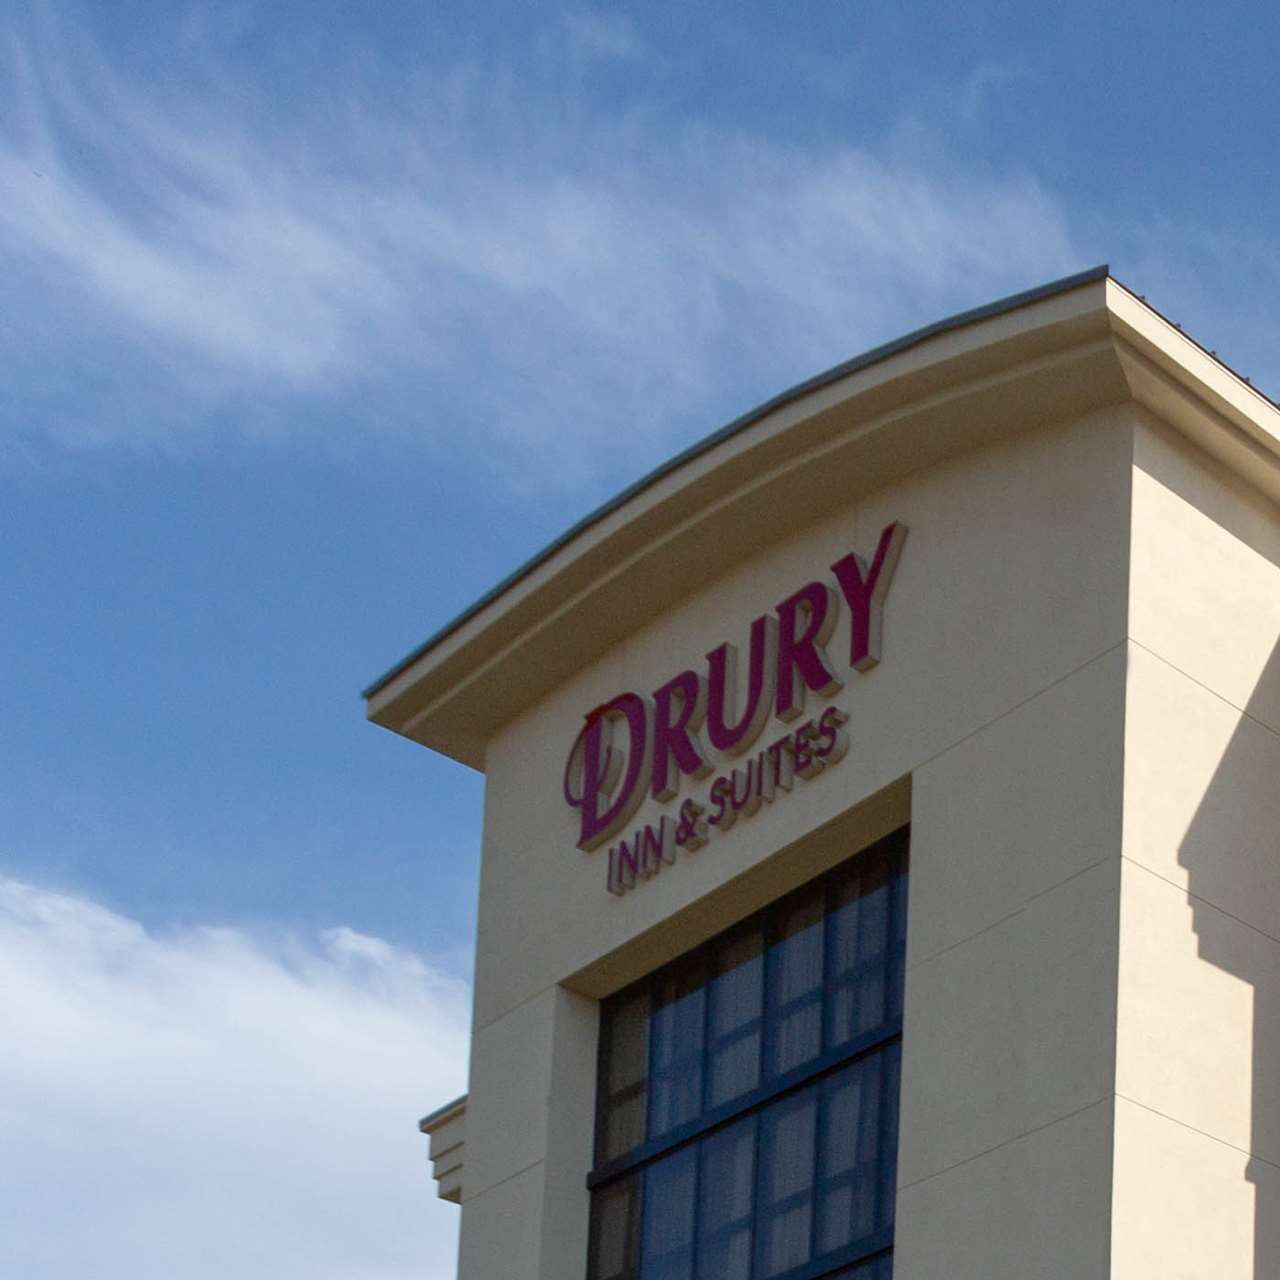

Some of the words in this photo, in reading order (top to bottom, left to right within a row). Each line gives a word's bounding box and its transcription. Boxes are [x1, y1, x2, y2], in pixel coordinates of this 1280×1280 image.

[564, 520, 909, 853] DRURY
[607, 815, 676, 897] INN
[674, 799, 709, 852] &
[707, 706, 850, 832] SUITES
